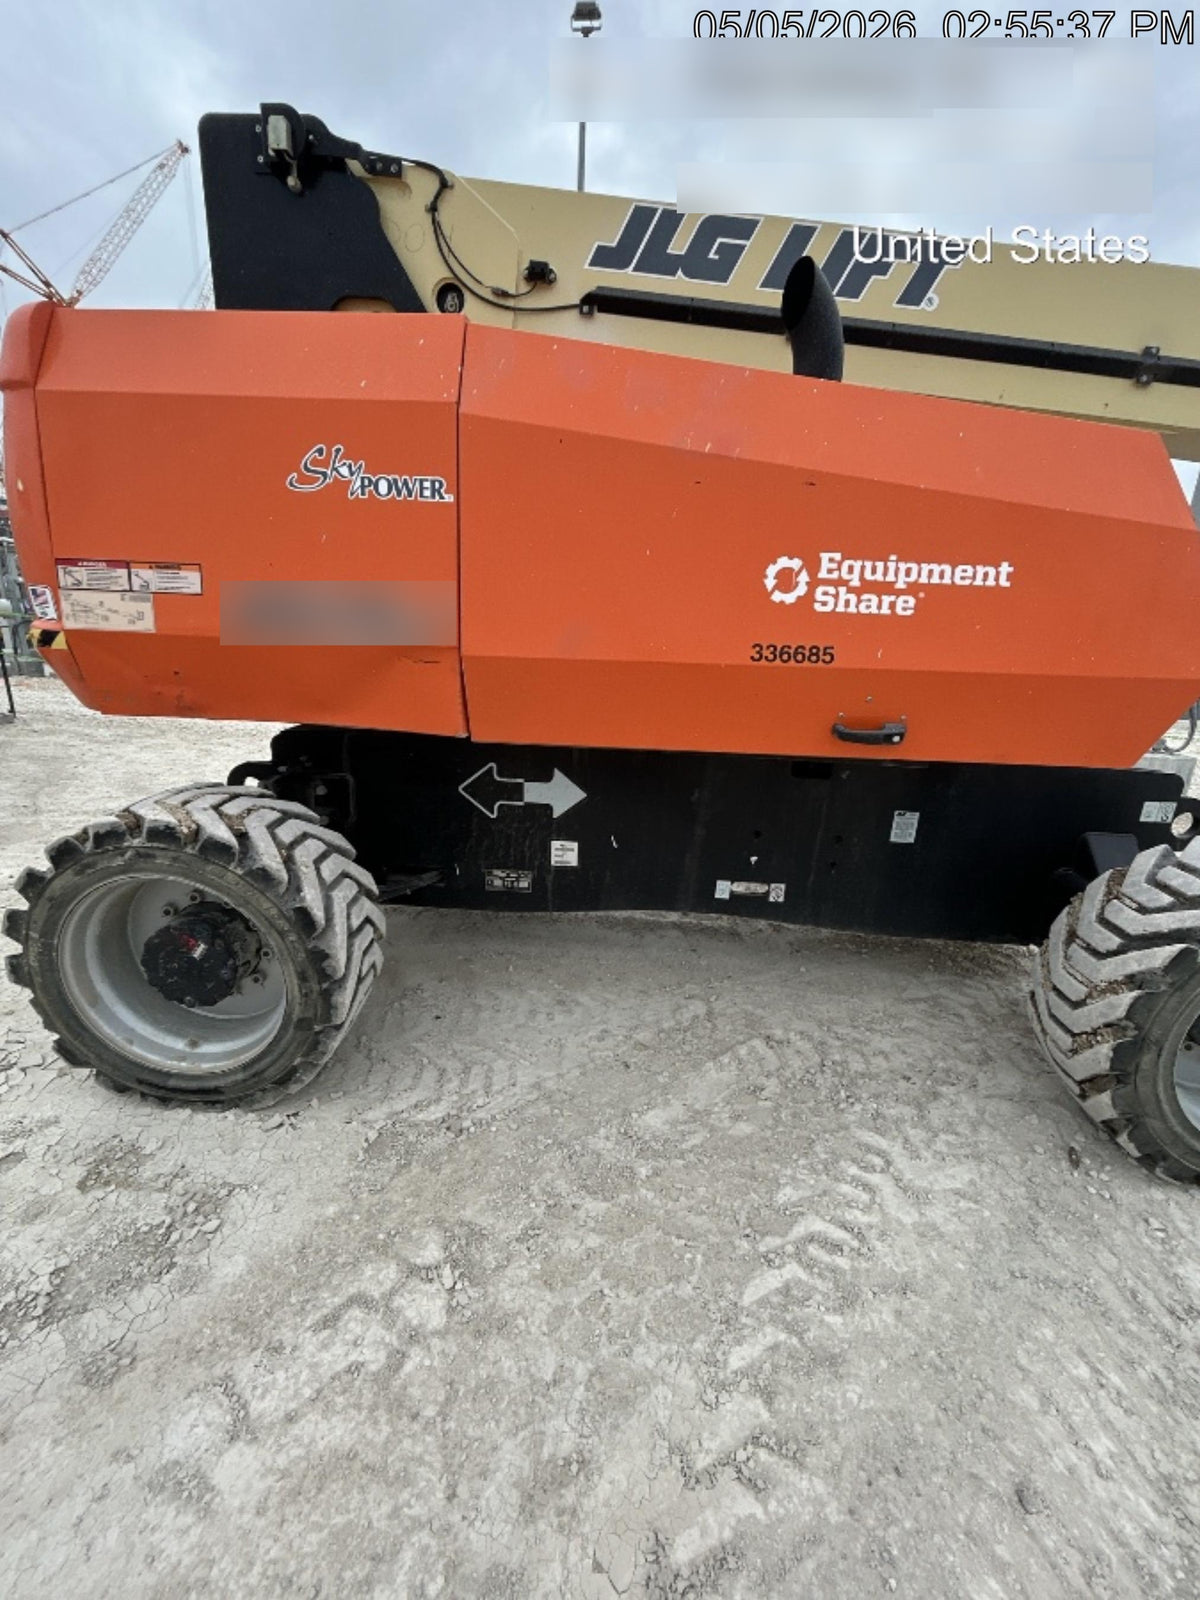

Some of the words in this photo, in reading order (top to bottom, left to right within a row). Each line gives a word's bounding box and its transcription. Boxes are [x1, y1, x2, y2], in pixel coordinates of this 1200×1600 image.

[585, 202, 764, 286] JLG
[286, 444, 365, 499] Sky
[358, 474, 453, 502] POWER
[817, 552, 1014, 589] Equipment
[813, 585, 917, 616] Share
[750, 643, 835, 664] 336685
